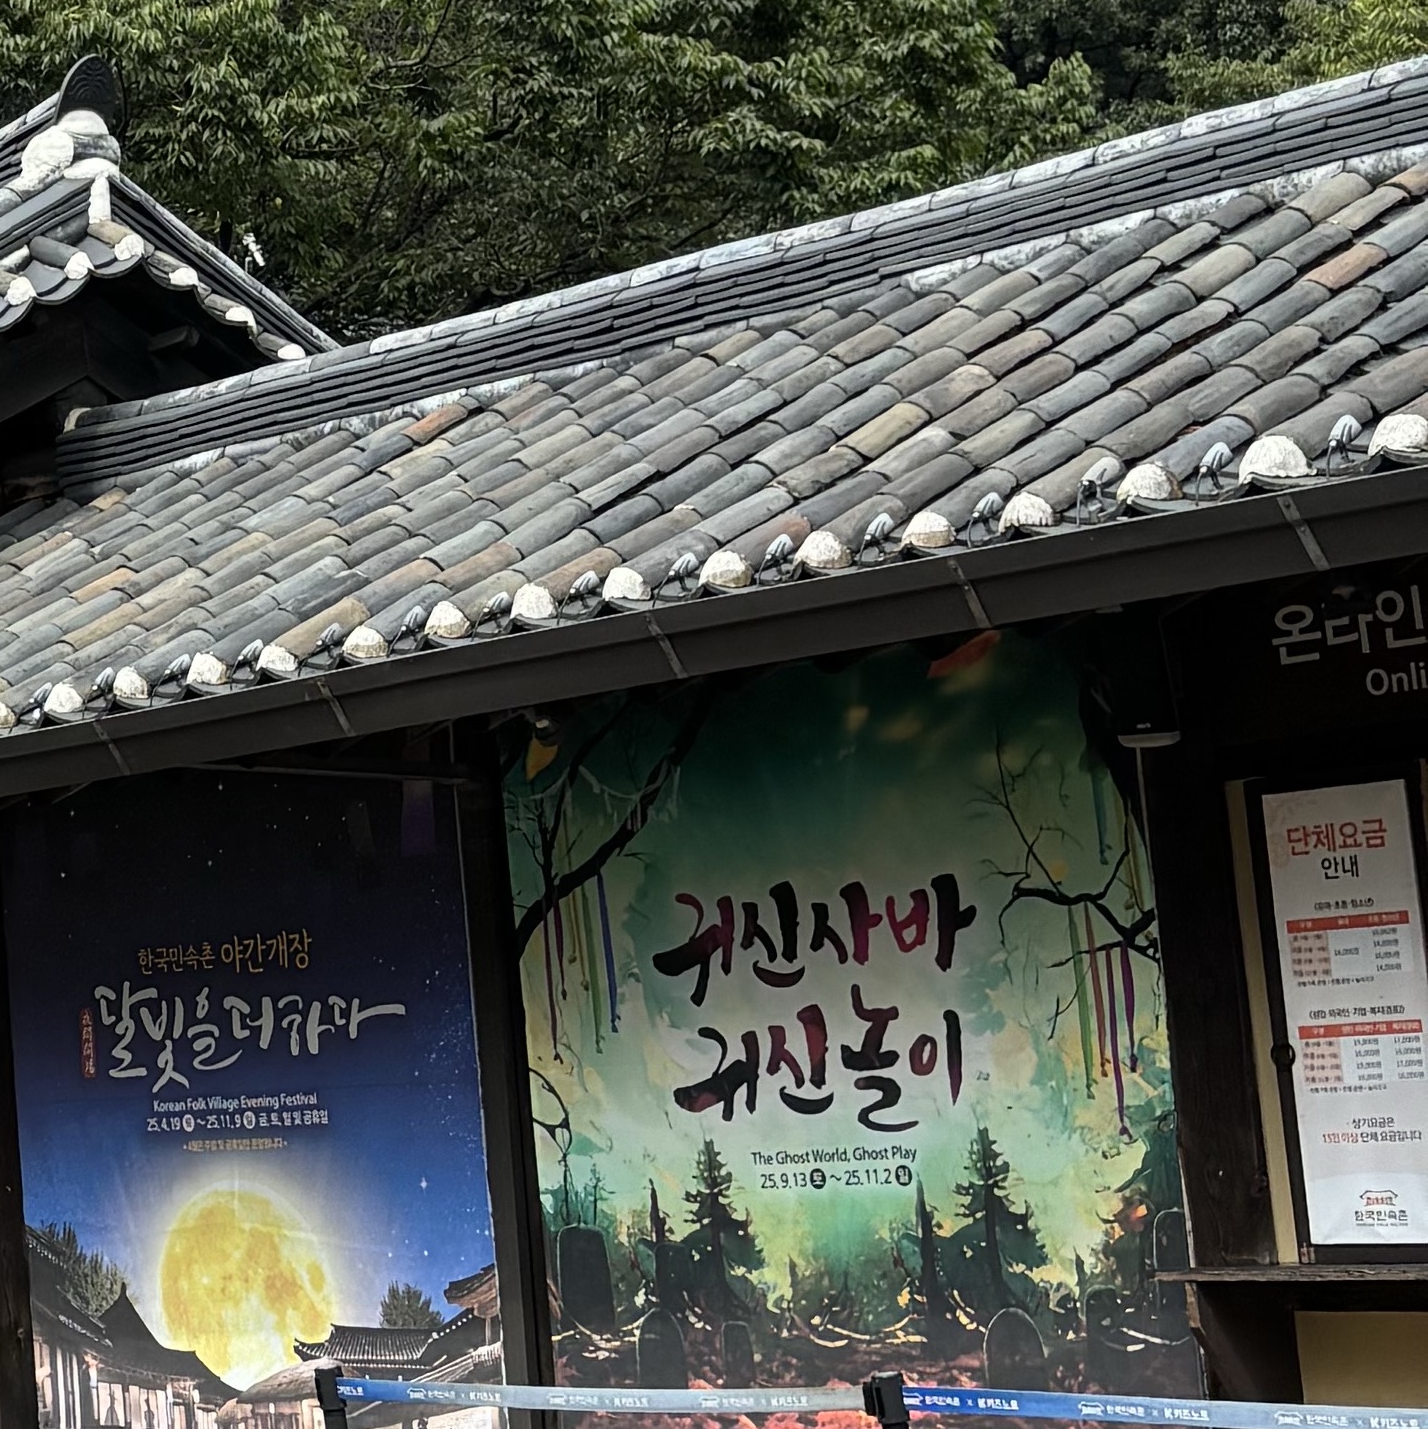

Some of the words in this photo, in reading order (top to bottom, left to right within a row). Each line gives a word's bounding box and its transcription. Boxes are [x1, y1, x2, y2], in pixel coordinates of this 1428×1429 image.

[1286, 818, 1387, 856] 단체요금
[1321, 854, 1359, 880] 안내
[138, 942, 215, 975] 한국민속촌
[221, 928, 312, 973] 야간개장
[652, 873, 977, 1007] 귀신사바
[673, 984, 963, 1133] 귀신놀이
[153, 1099, 186, 1112] Korean
[187, 1098, 207, 1110] Folk
[208, 1095, 240, 1112] Village
[241, 1094, 280, 1110] Evening
[280, 1092, 317, 1106] Festival
[751, 1152, 773, 1165] The
[776, 1150, 810, 1165] Ghost
[812, 1147, 851, 1164] World,
[852, 1146, 889, 1161] Ghost
[892, 1145, 917, 1162] Play
